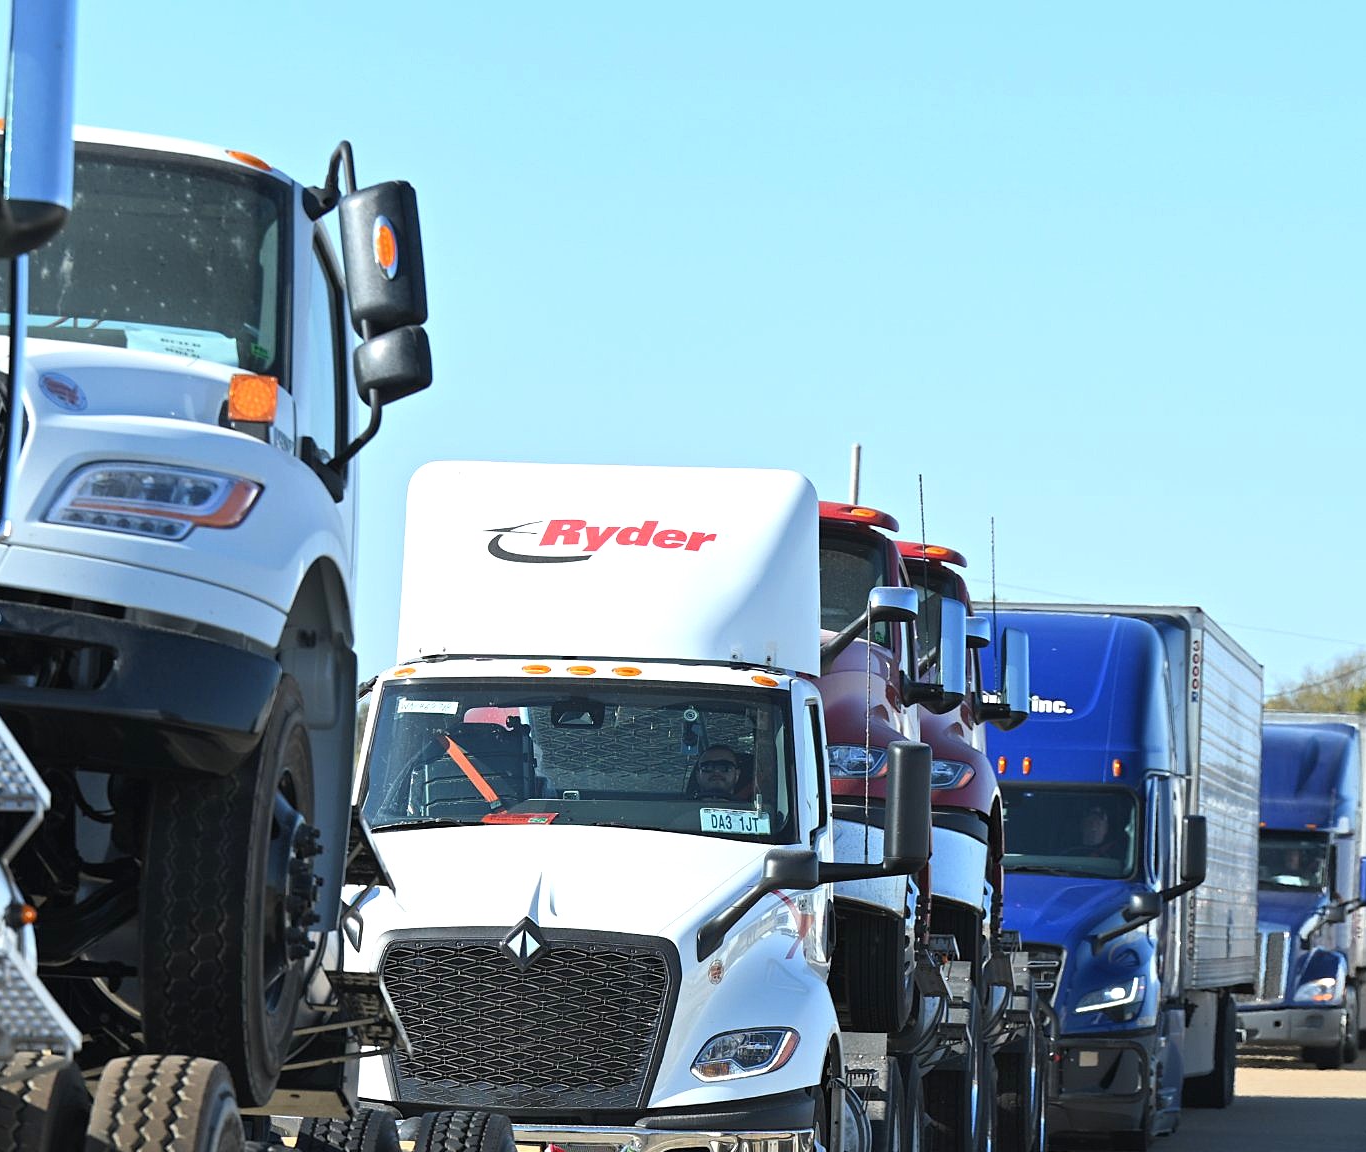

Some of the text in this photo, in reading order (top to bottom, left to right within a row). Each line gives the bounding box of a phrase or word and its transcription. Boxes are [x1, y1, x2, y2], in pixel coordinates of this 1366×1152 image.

[538, 518, 718, 552] Ryder
[1031, 695, 1074, 714] inc.
[710, 813, 733, 830] DA3
